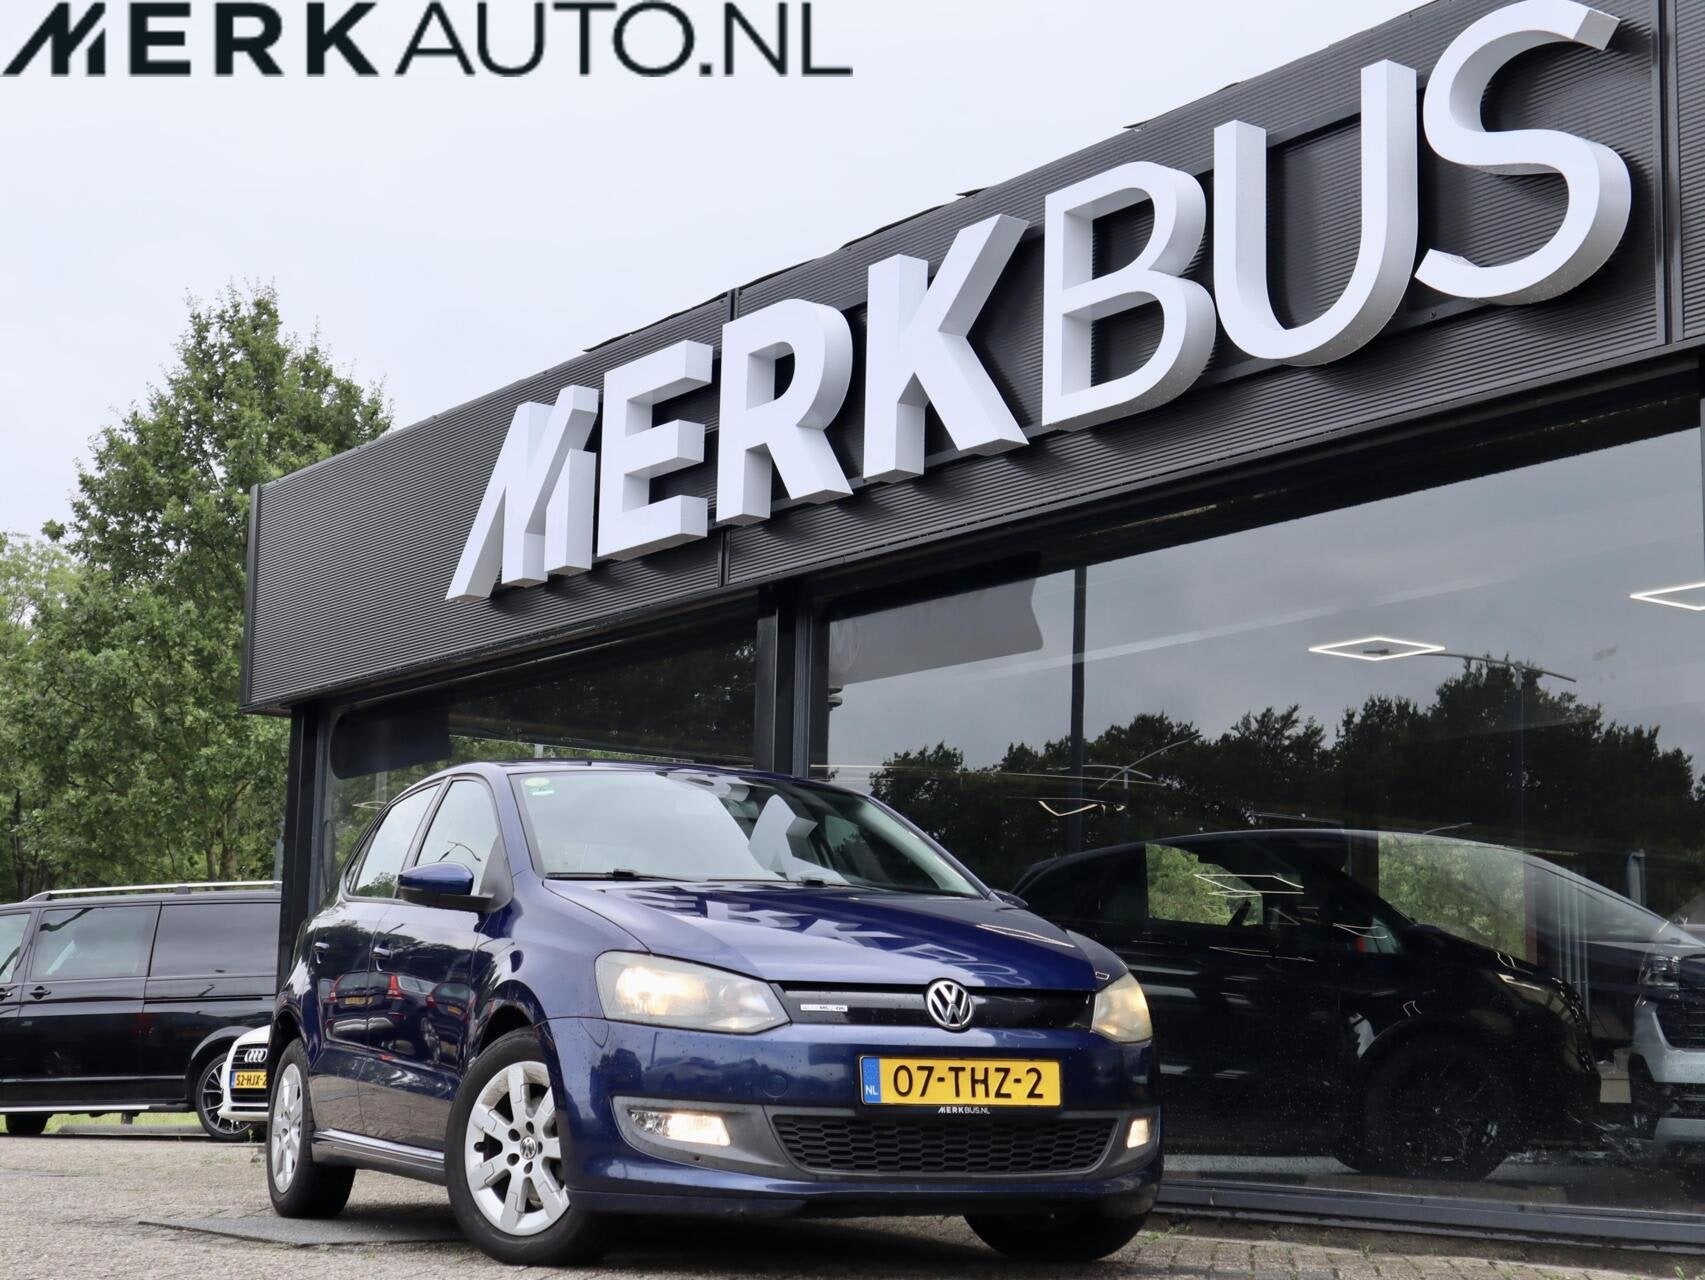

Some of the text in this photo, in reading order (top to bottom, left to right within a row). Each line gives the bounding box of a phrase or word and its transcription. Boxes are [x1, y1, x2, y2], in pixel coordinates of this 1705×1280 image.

[446, 0, 1632, 602] MERKBUS
[865, 1084, 879, 1096] NL
[893, 1064, 1044, 1099] 07-THZ-2
[938, 1106, 991, 1115] MERKBUS.NL
